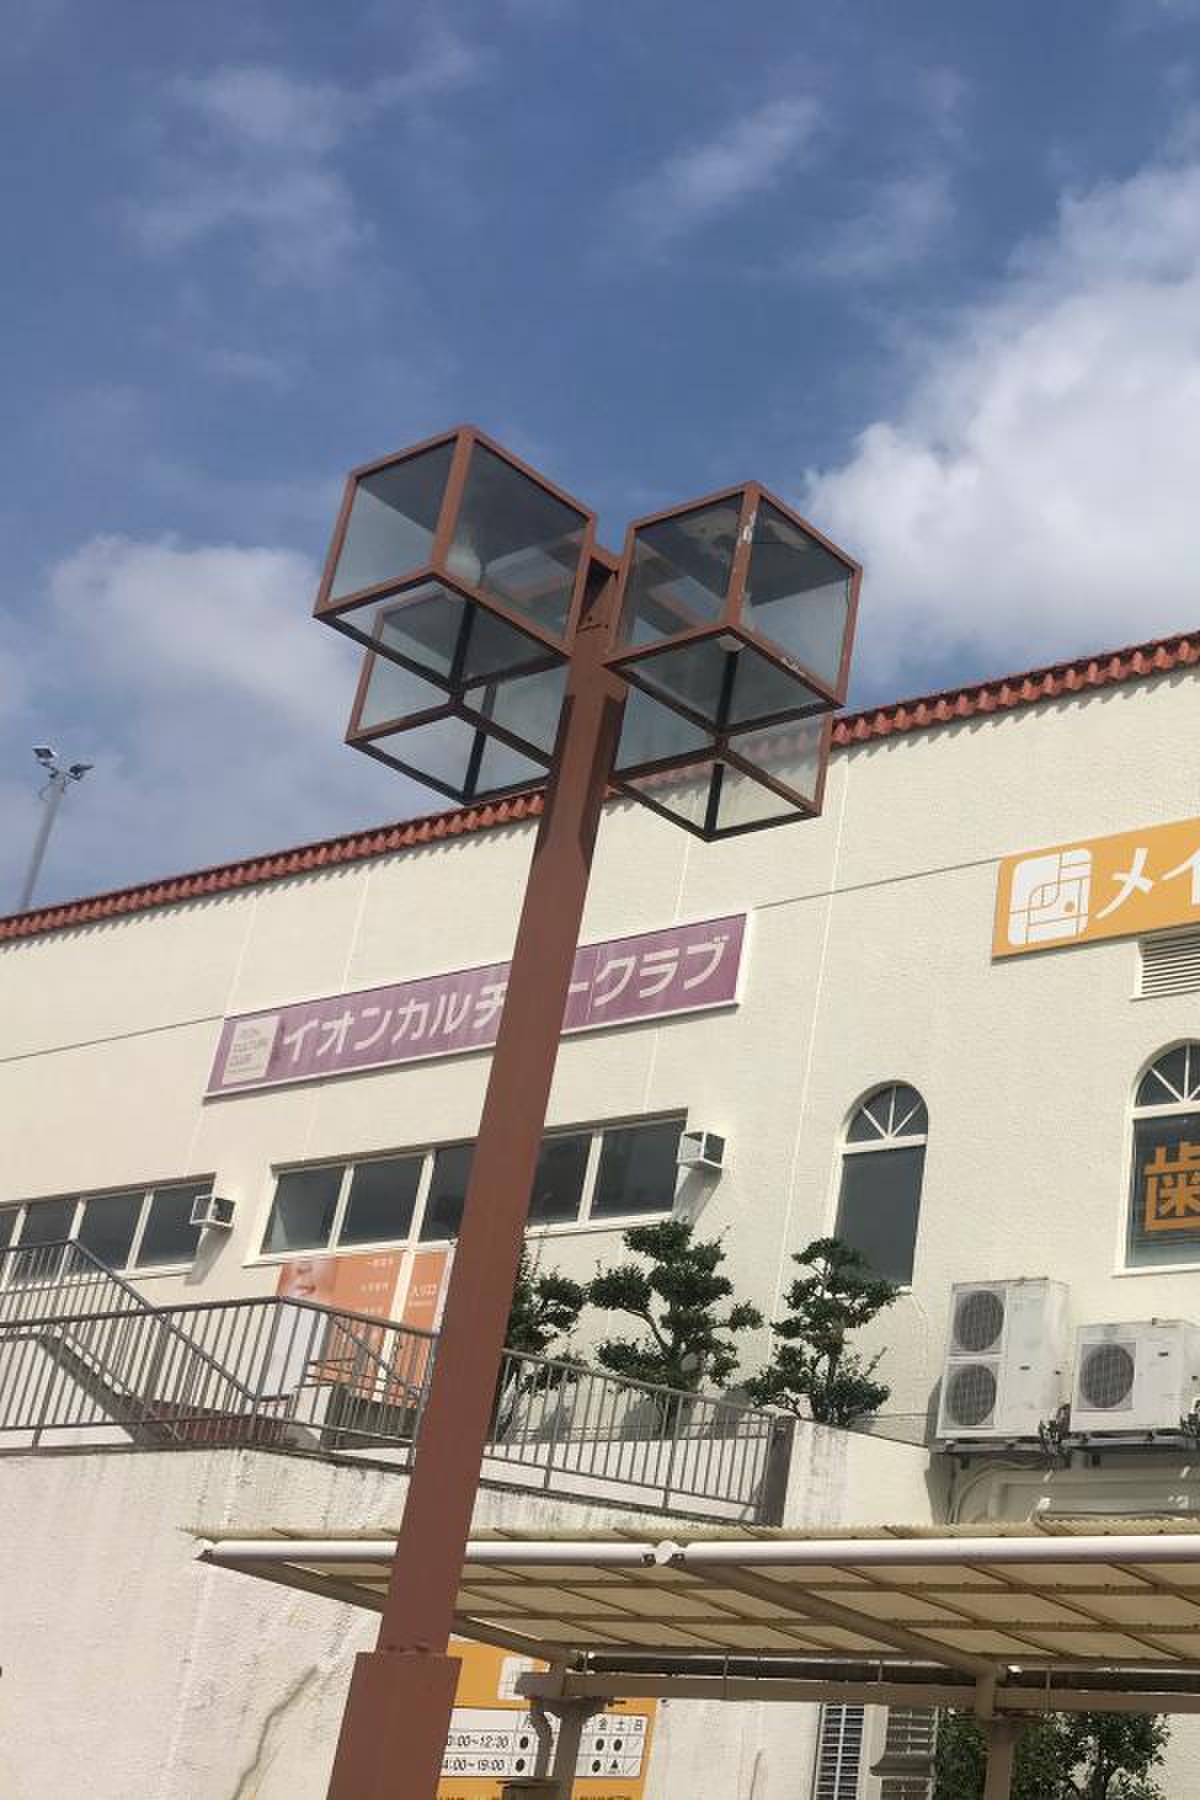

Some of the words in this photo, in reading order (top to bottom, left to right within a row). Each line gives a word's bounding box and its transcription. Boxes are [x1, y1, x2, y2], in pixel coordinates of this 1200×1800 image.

[282, 934, 729, 1063] イオンカルチークラブ
